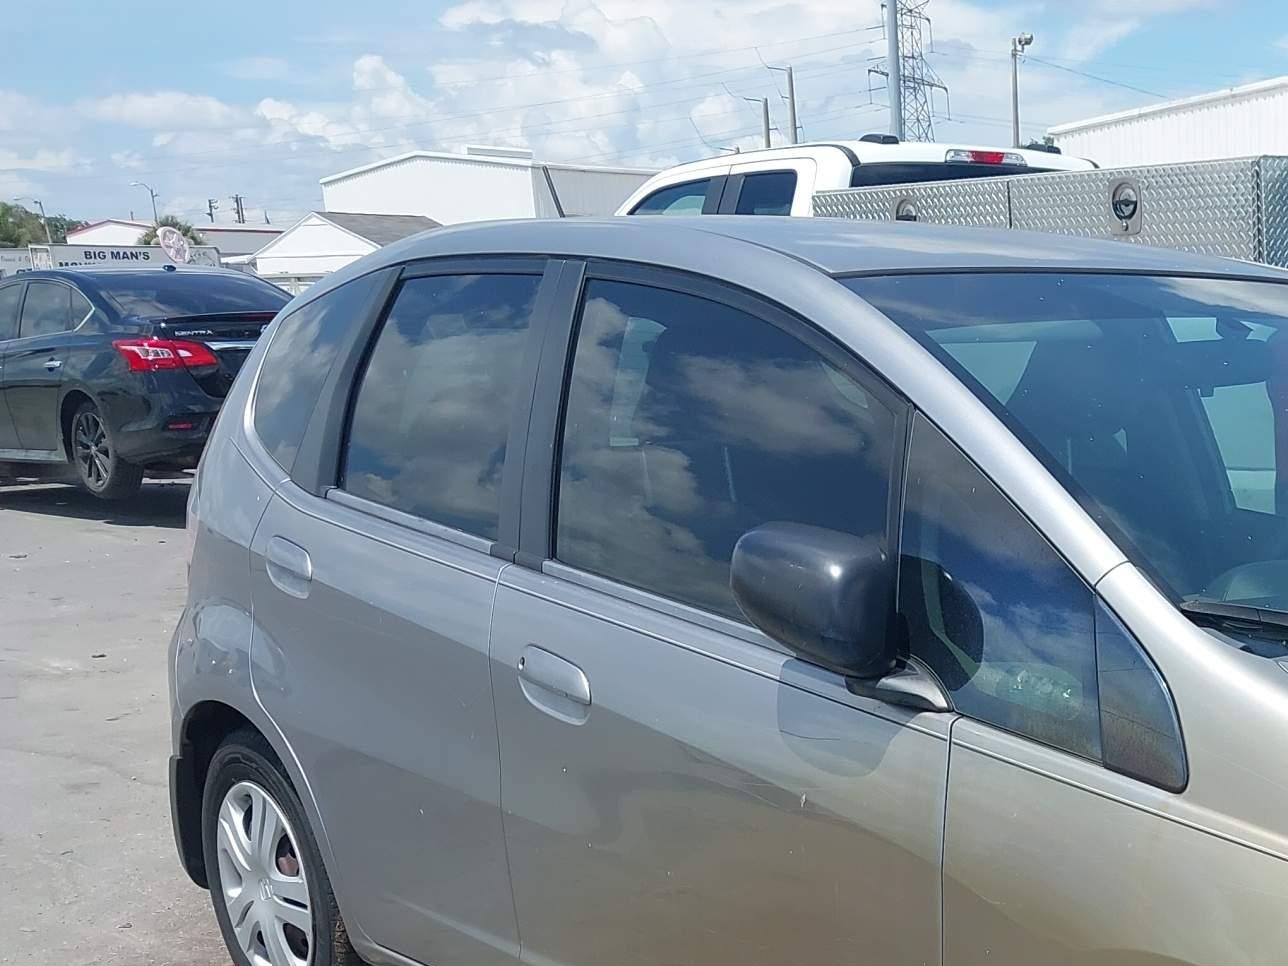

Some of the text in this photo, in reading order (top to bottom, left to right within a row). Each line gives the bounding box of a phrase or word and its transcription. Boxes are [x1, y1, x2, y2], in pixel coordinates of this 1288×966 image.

[84, 250, 150, 261] BIG MAN'S
[174, 329, 213, 337] SENTRA
